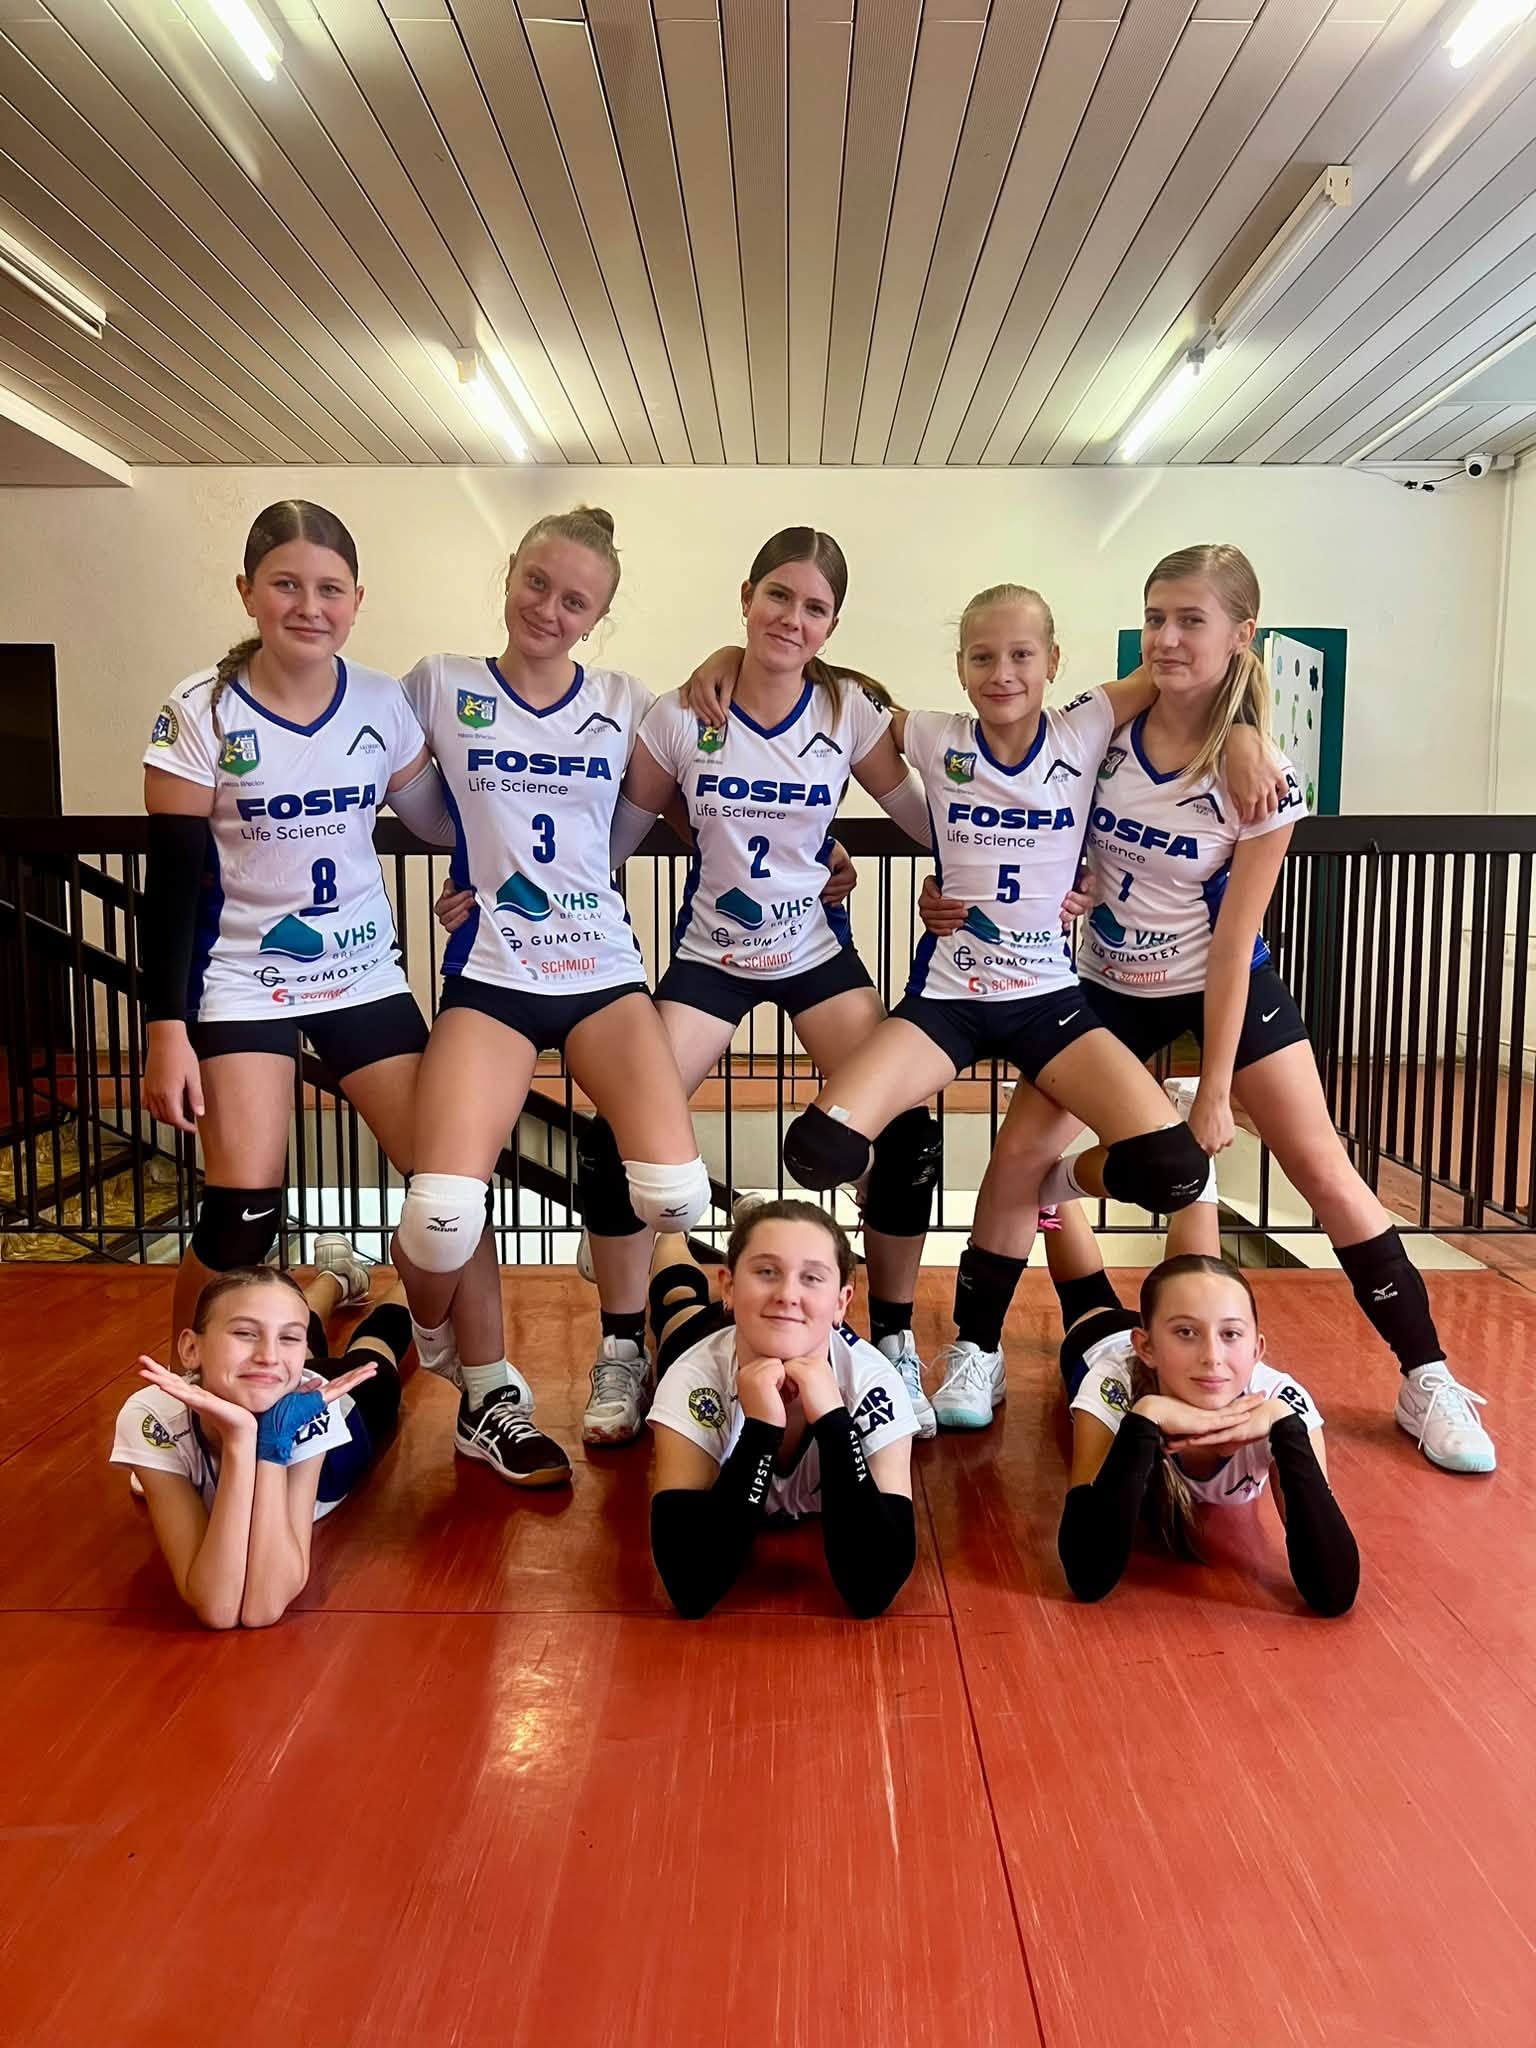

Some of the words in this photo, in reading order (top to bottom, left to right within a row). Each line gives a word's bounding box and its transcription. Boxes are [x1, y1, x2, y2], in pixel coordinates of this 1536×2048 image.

[467, 749, 612, 780] FOSFA
[468, 778, 496, 793] Life
[501, 779, 569, 795] Science
[696, 774, 832, 806] FOSFA
[236, 784, 376, 821] FOSFA
[695, 803, 717, 817] Life
[722, 805, 786, 820] Science
[948, 802, 1075, 830] FOSFA
[241, 825, 271, 841] Life
[277, 821, 346, 839] Science
[532, 813, 556, 864] 3
[947, 829, 970, 844] Life
[974, 832, 1036, 848] Science
[1093, 807, 1199, 860] OSFA
[748, 835, 771, 878] 2
[311, 857, 340, 917] 8
[995, 864, 1021, 904] 5
[553, 892, 598, 910] VHS
[771, 897, 814, 920] VHS
[333, 921, 376, 949] VHS
[541, 956, 597, 974] SCHMIDT
[744, 950, 794, 969] SCHMIDT
[1110, 945, 1180, 963] GUMOTEX
[292, 1415, 331, 1446] LAY
[855, 1401, 896, 1440] LAY
[849, 1430, 867, 1482] KIPSTA
